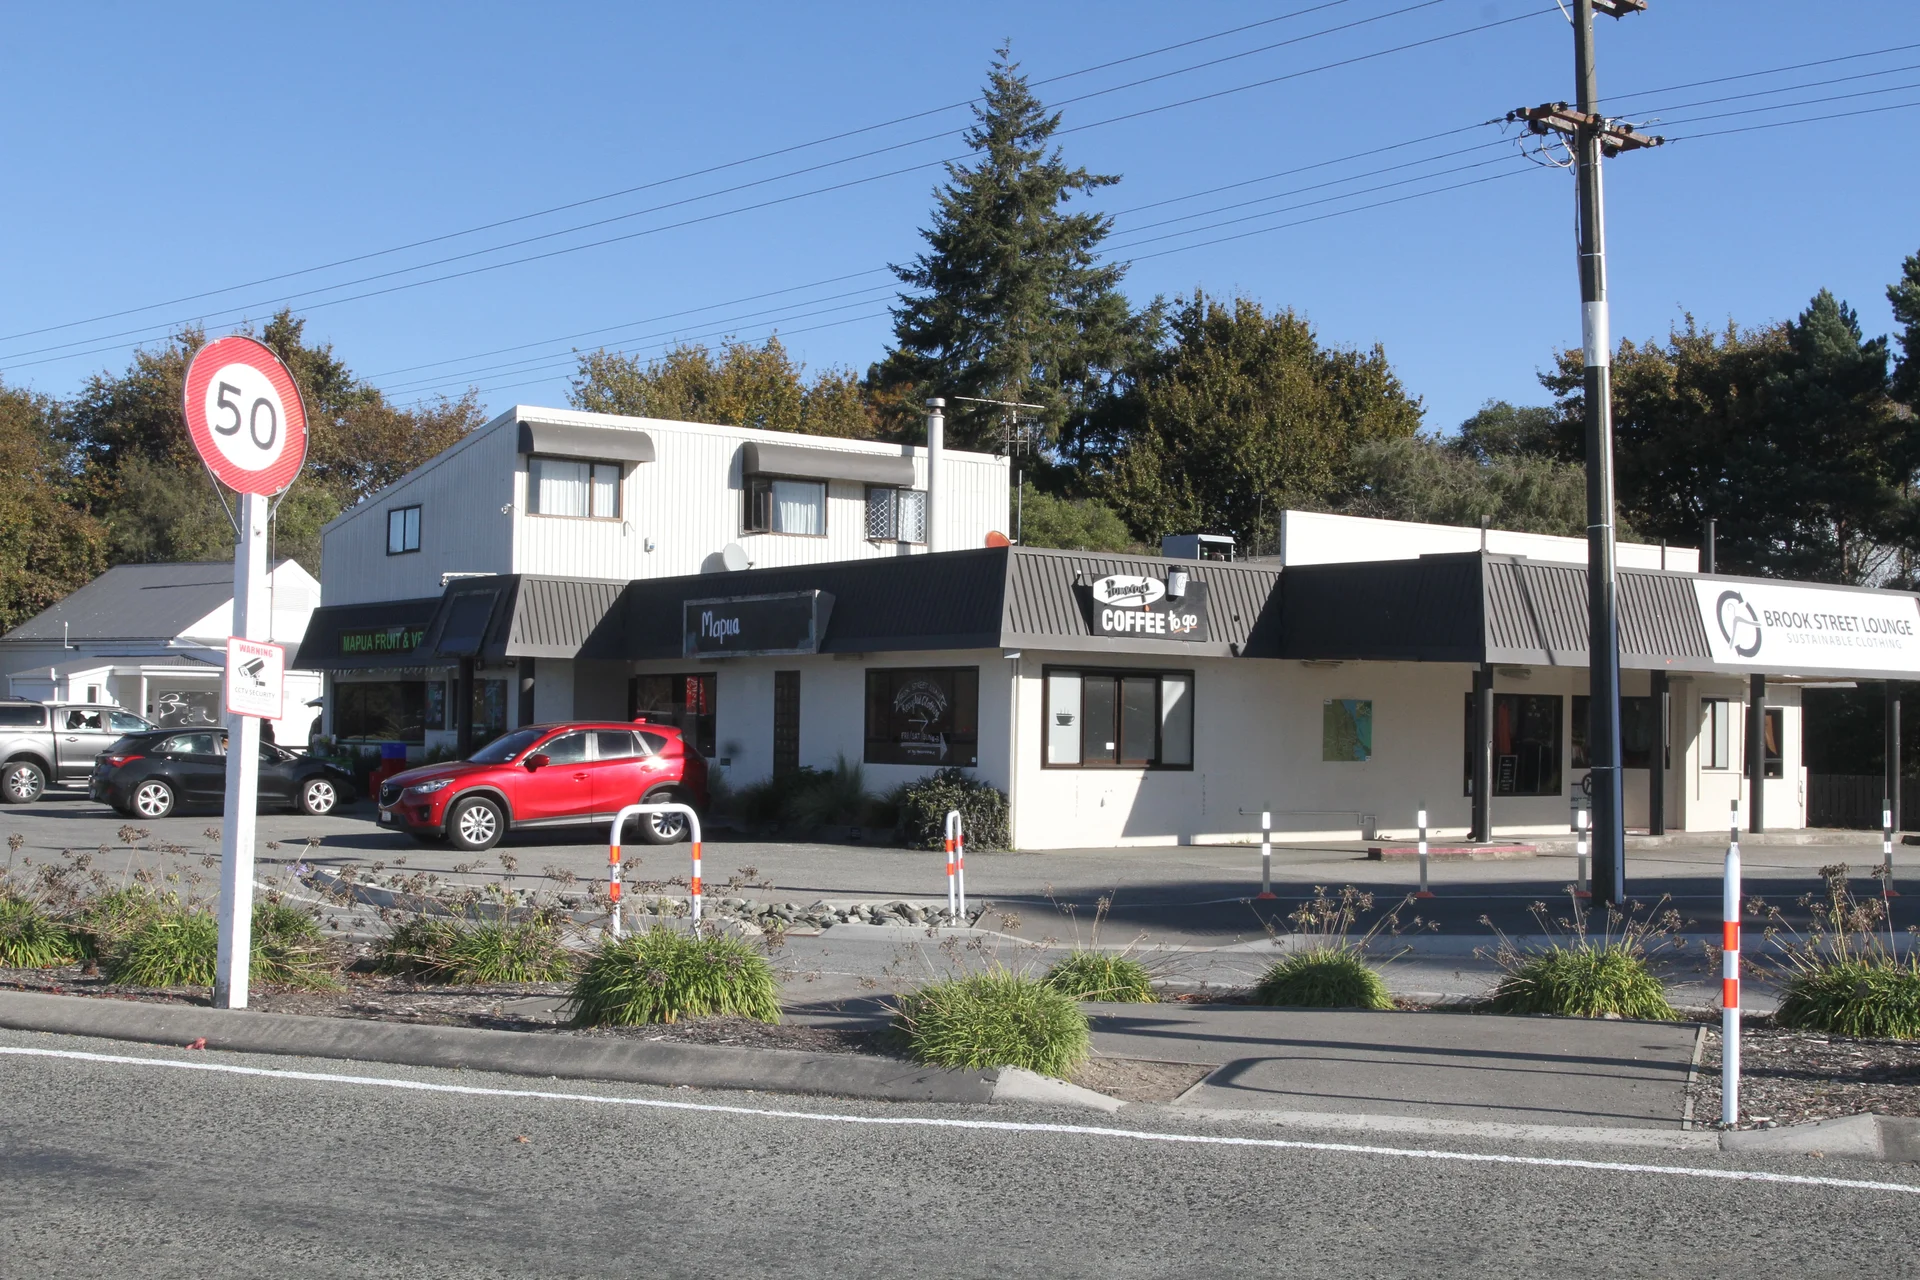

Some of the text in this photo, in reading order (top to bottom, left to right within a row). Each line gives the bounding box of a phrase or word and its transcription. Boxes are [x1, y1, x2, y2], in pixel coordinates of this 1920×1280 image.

[214, 380, 278, 451] 50
[701, 610, 741, 644] Mapua
[1101, 609, 1198, 634] COFFEE to go
[1763, 609, 1914, 636] BROOK STREET LOUNGE
[238, 643, 274, 658] WARNING
[342, 634, 373, 652] MAPUA
[375, 632, 401, 650] FRUIT
[402, 632, 410, 648] &
[1786, 632, 1903, 650] SUSTAINABLE CLOTHING
[234, 686, 249, 695] CCTV
[249, 689, 276, 699] SECURITY
